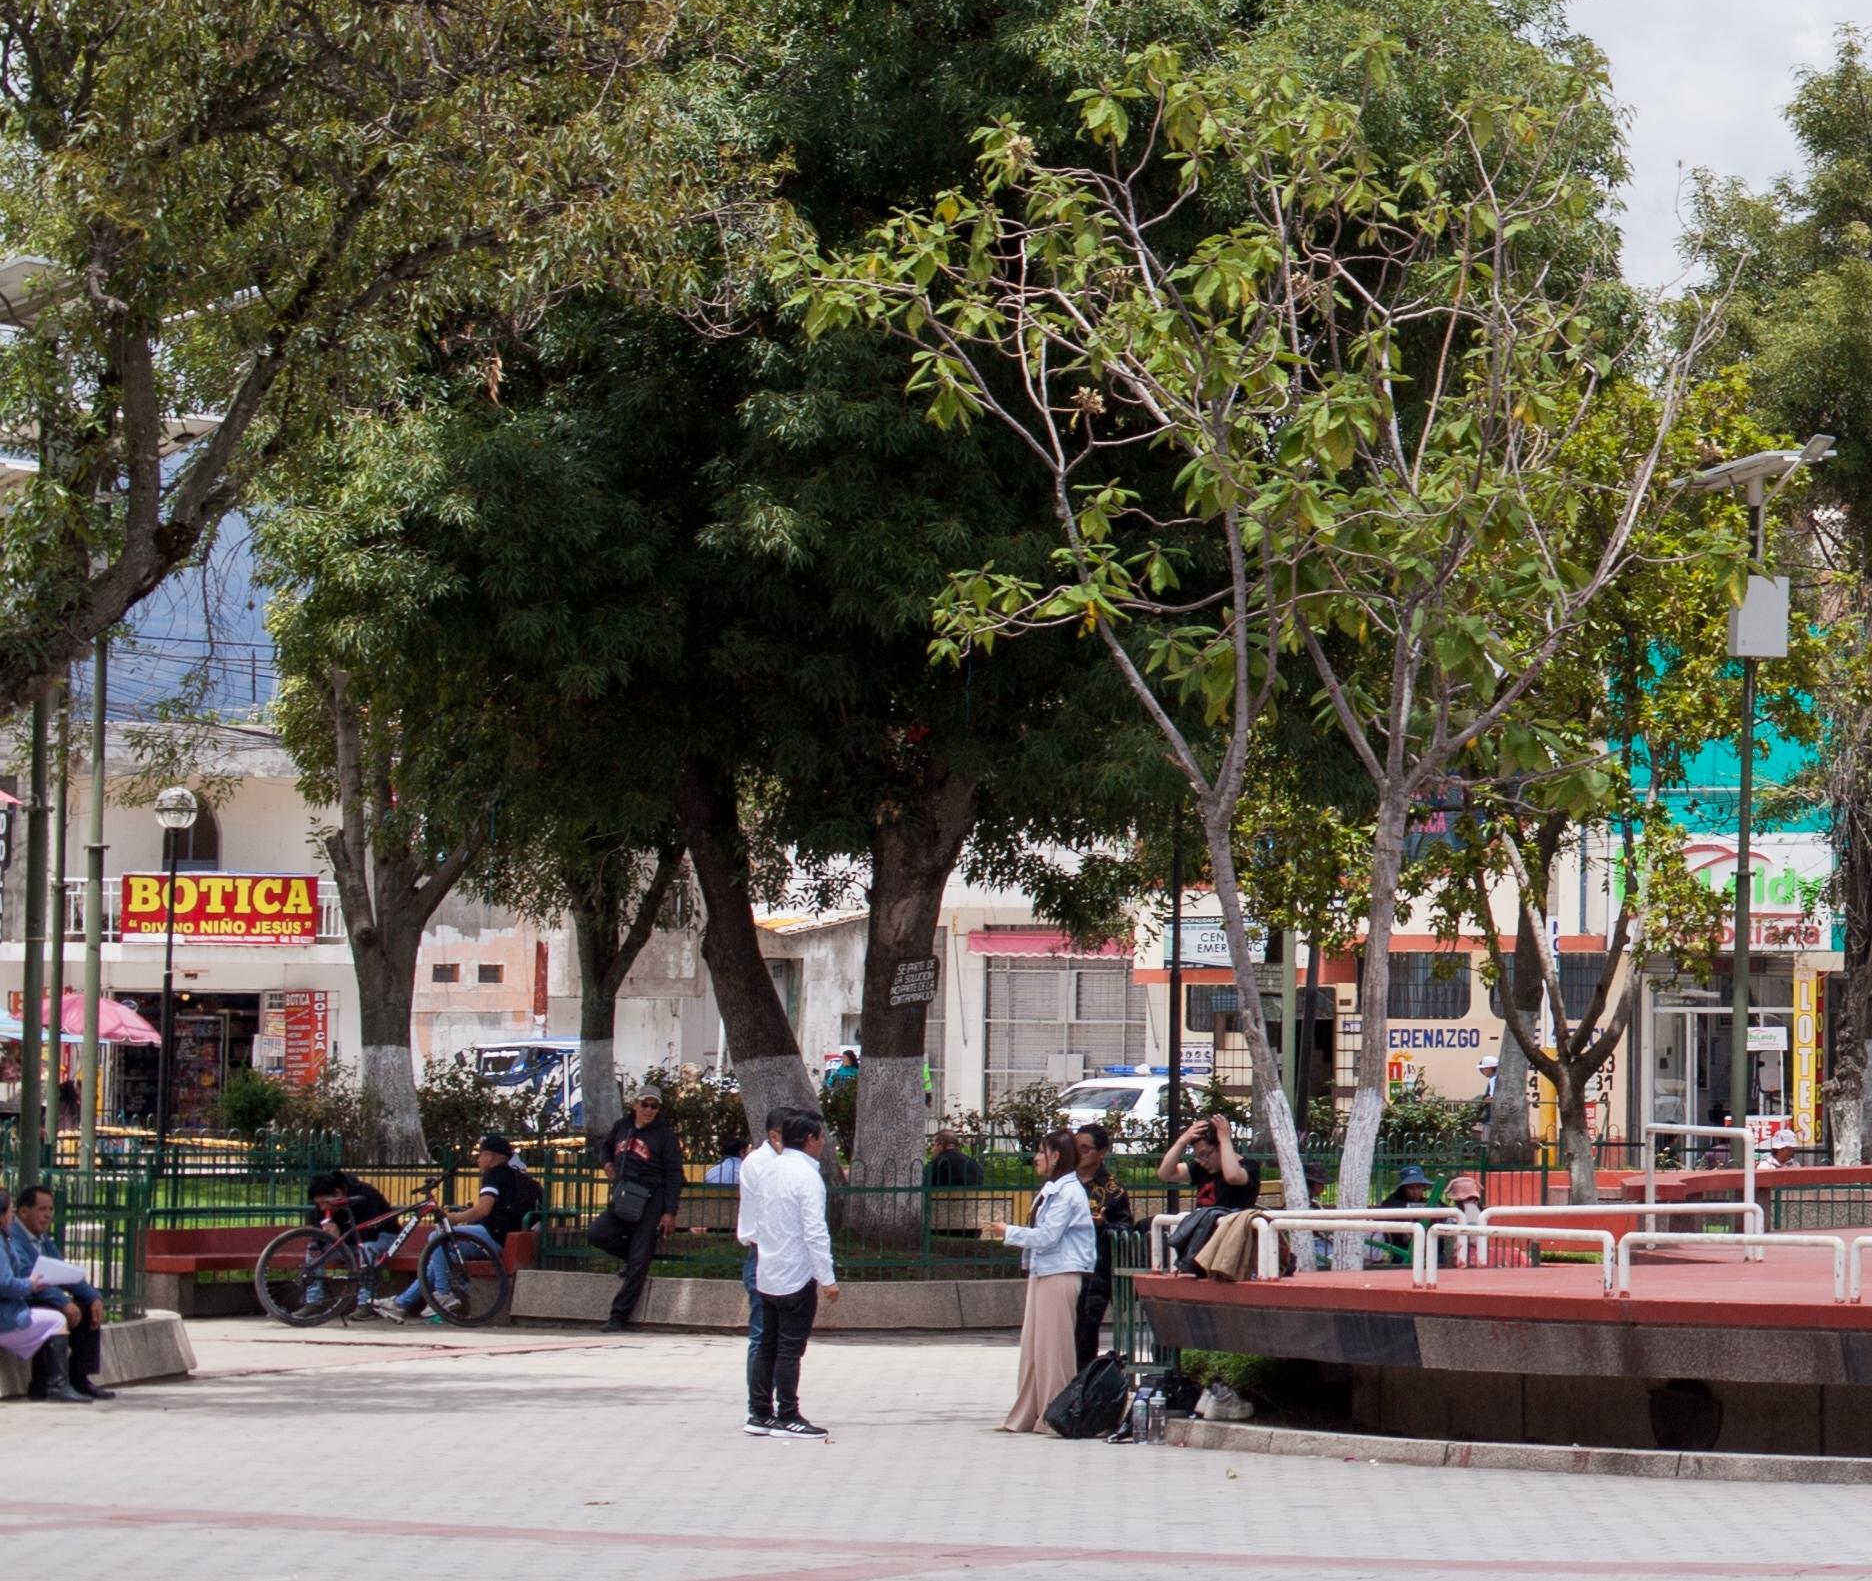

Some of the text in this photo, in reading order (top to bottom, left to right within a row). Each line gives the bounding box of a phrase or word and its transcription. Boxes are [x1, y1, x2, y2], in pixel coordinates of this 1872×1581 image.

[128, 877, 313, 914] BOTICA
[141, 921, 194, 934] DIVNO
[200, 918, 246, 934] NIÑO
[1200, 932, 1225, 942] CEN
[314, 992, 326, 1050] BOTICA
[1388, 1028, 1481, 1049] ERENAZGO
[1798, 982, 1813, 1142] LOTES
[1816, 976, 1825, 1142] LOTES
